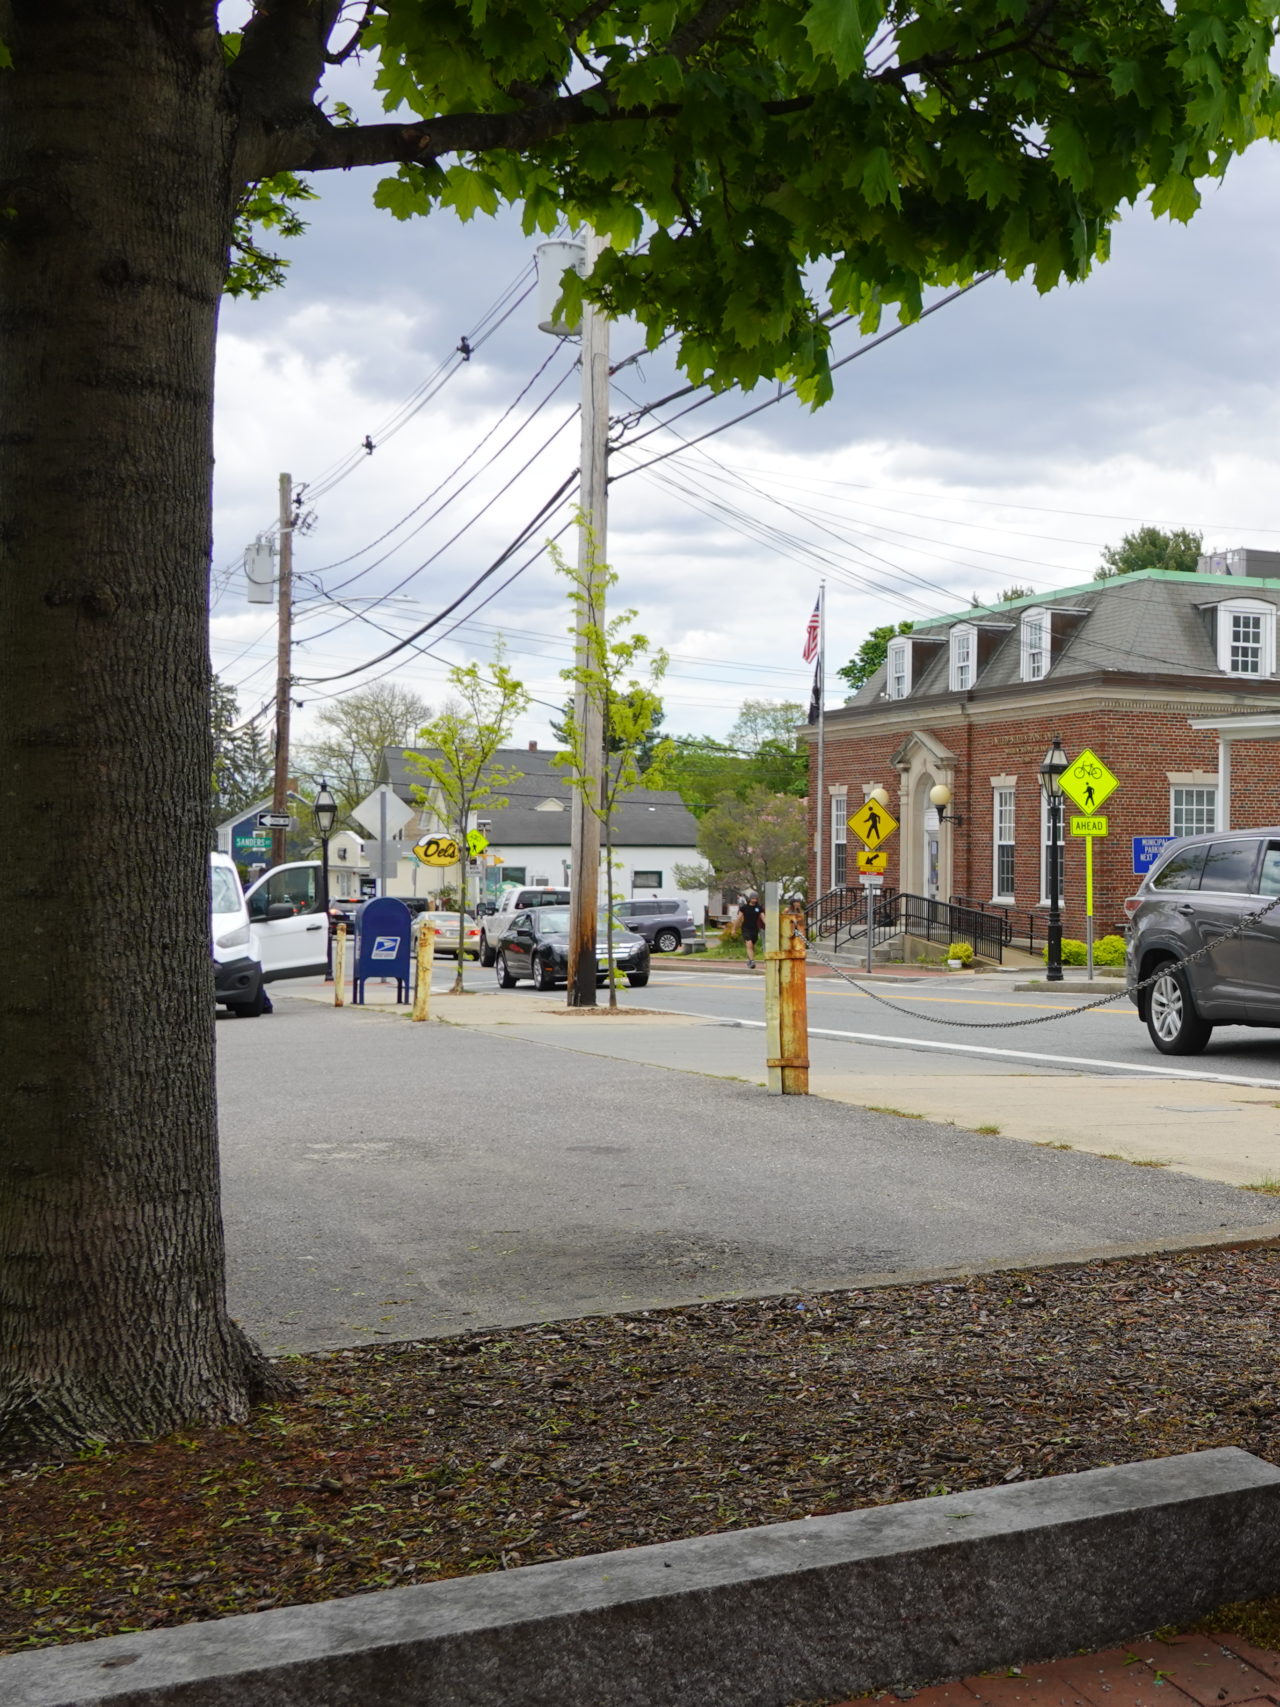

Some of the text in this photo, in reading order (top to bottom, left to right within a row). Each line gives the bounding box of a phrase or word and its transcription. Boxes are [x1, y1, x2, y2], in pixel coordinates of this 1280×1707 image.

[1075, 821, 1103, 831] AHEAD
[236, 838, 265, 847] SANDERS
[1144, 846, 1165, 854] PARKIN
[1140, 853, 1153, 861] NEXT
